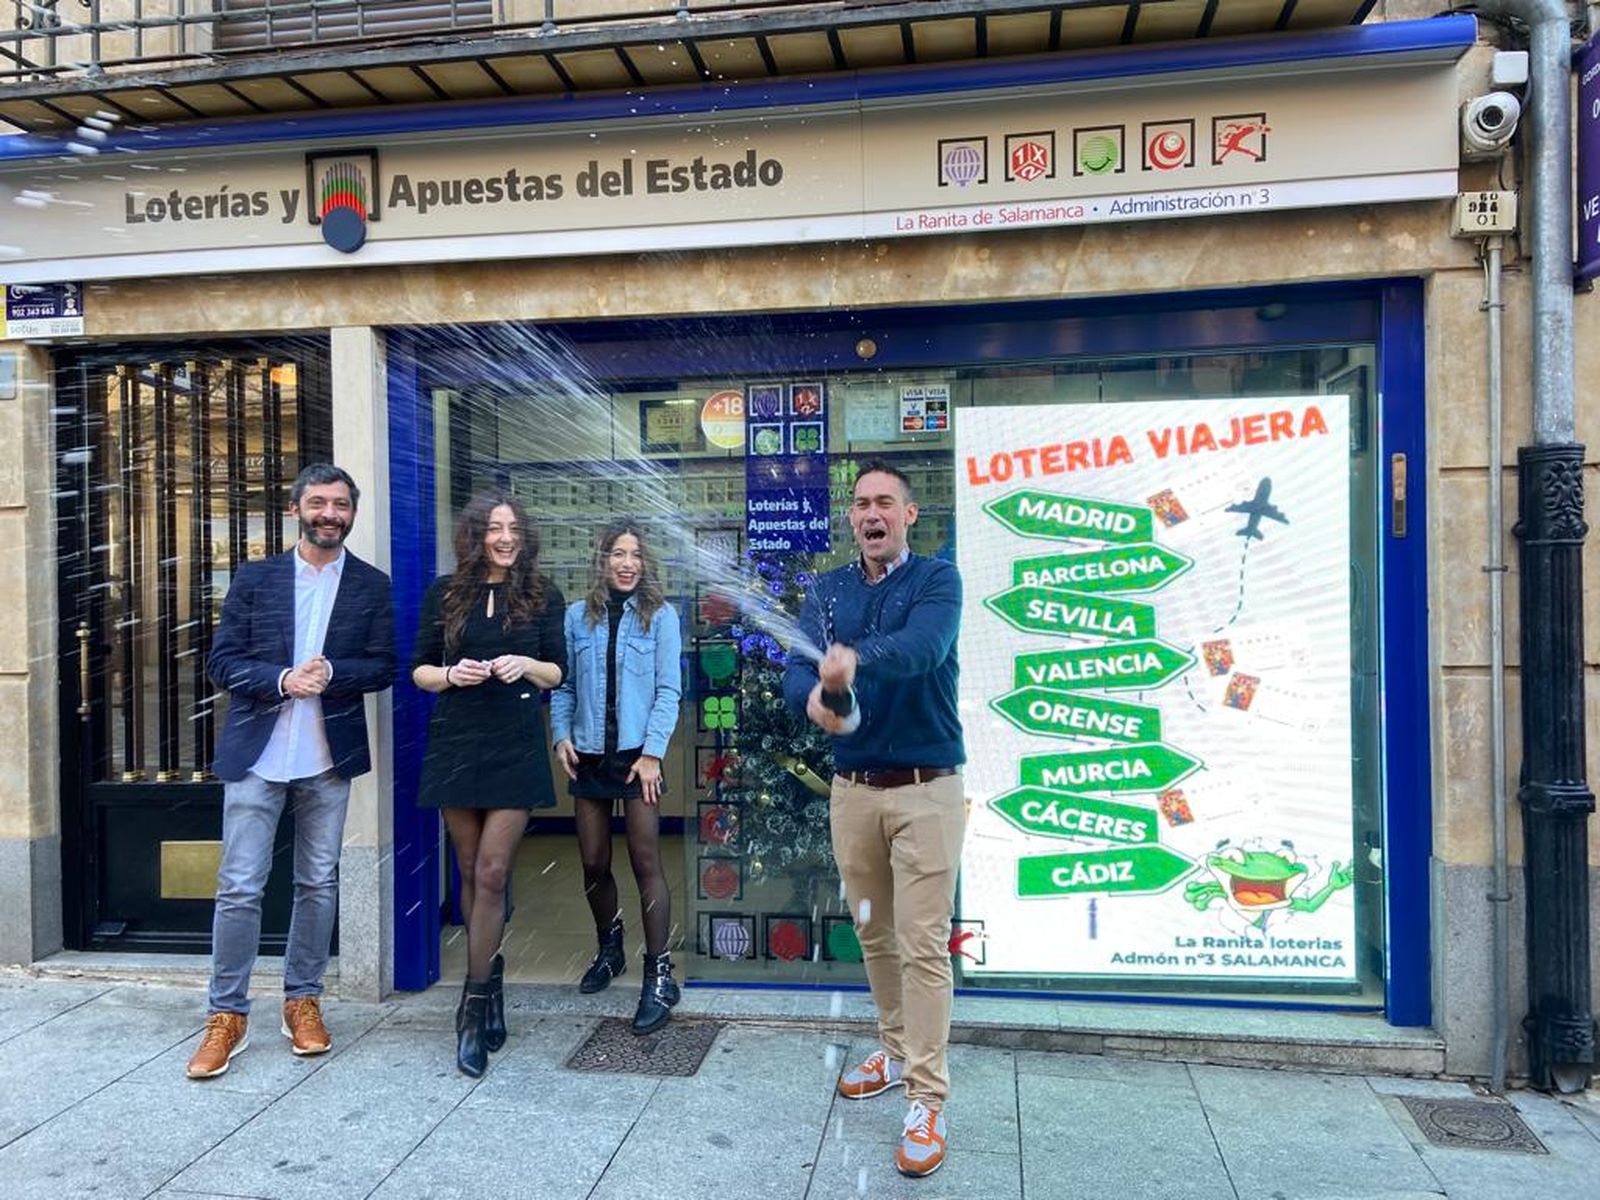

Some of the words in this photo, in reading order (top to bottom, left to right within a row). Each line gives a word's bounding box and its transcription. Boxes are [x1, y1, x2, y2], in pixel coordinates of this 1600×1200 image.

[125, 185, 269, 224] Loterías
[280, 189, 300, 224] y
[388, 168, 564, 214] Apuestas
[576, 158, 633, 198] del
[646, 150, 784, 195] Estado
[896, 216, 914, 231] La
[918, 211, 968, 229] Ranita
[972, 209, 993, 225] de
[999, 205, 1084, 224] Salamanca
[1109, 191, 1235, 216] Administración
[1259, 188, 1270, 205] 3
[966, 435, 1134, 485] LOTERIA
[1146, 405, 1329, 459] VIAJERA
[748, 518, 806, 534] Apuestas
[809, 517, 828, 530] del
[1017, 497, 1137, 535] MADRID
[749, 537, 791, 550] Estado
[1022, 554, 1167, 588] BARCELONA
[1026, 599, 1137, 637] SEVILLA
[1026, 651, 1163, 684] VALENCIA
[1028, 699, 1143, 738] ORENSE
[1041, 757, 1152, 787] MURCIA
[1020, 799, 1148, 843] CÁCERES
[1051, 860, 1136, 888] CÁDIZ
[1111, 951, 1179, 965] Admón
[1220, 953, 1347, 968] SALAMANCA
[1174, 936, 1197, 948] La
[1202, 936, 1264, 949] Ranita
[1270, 936, 1343, 950] loterias
